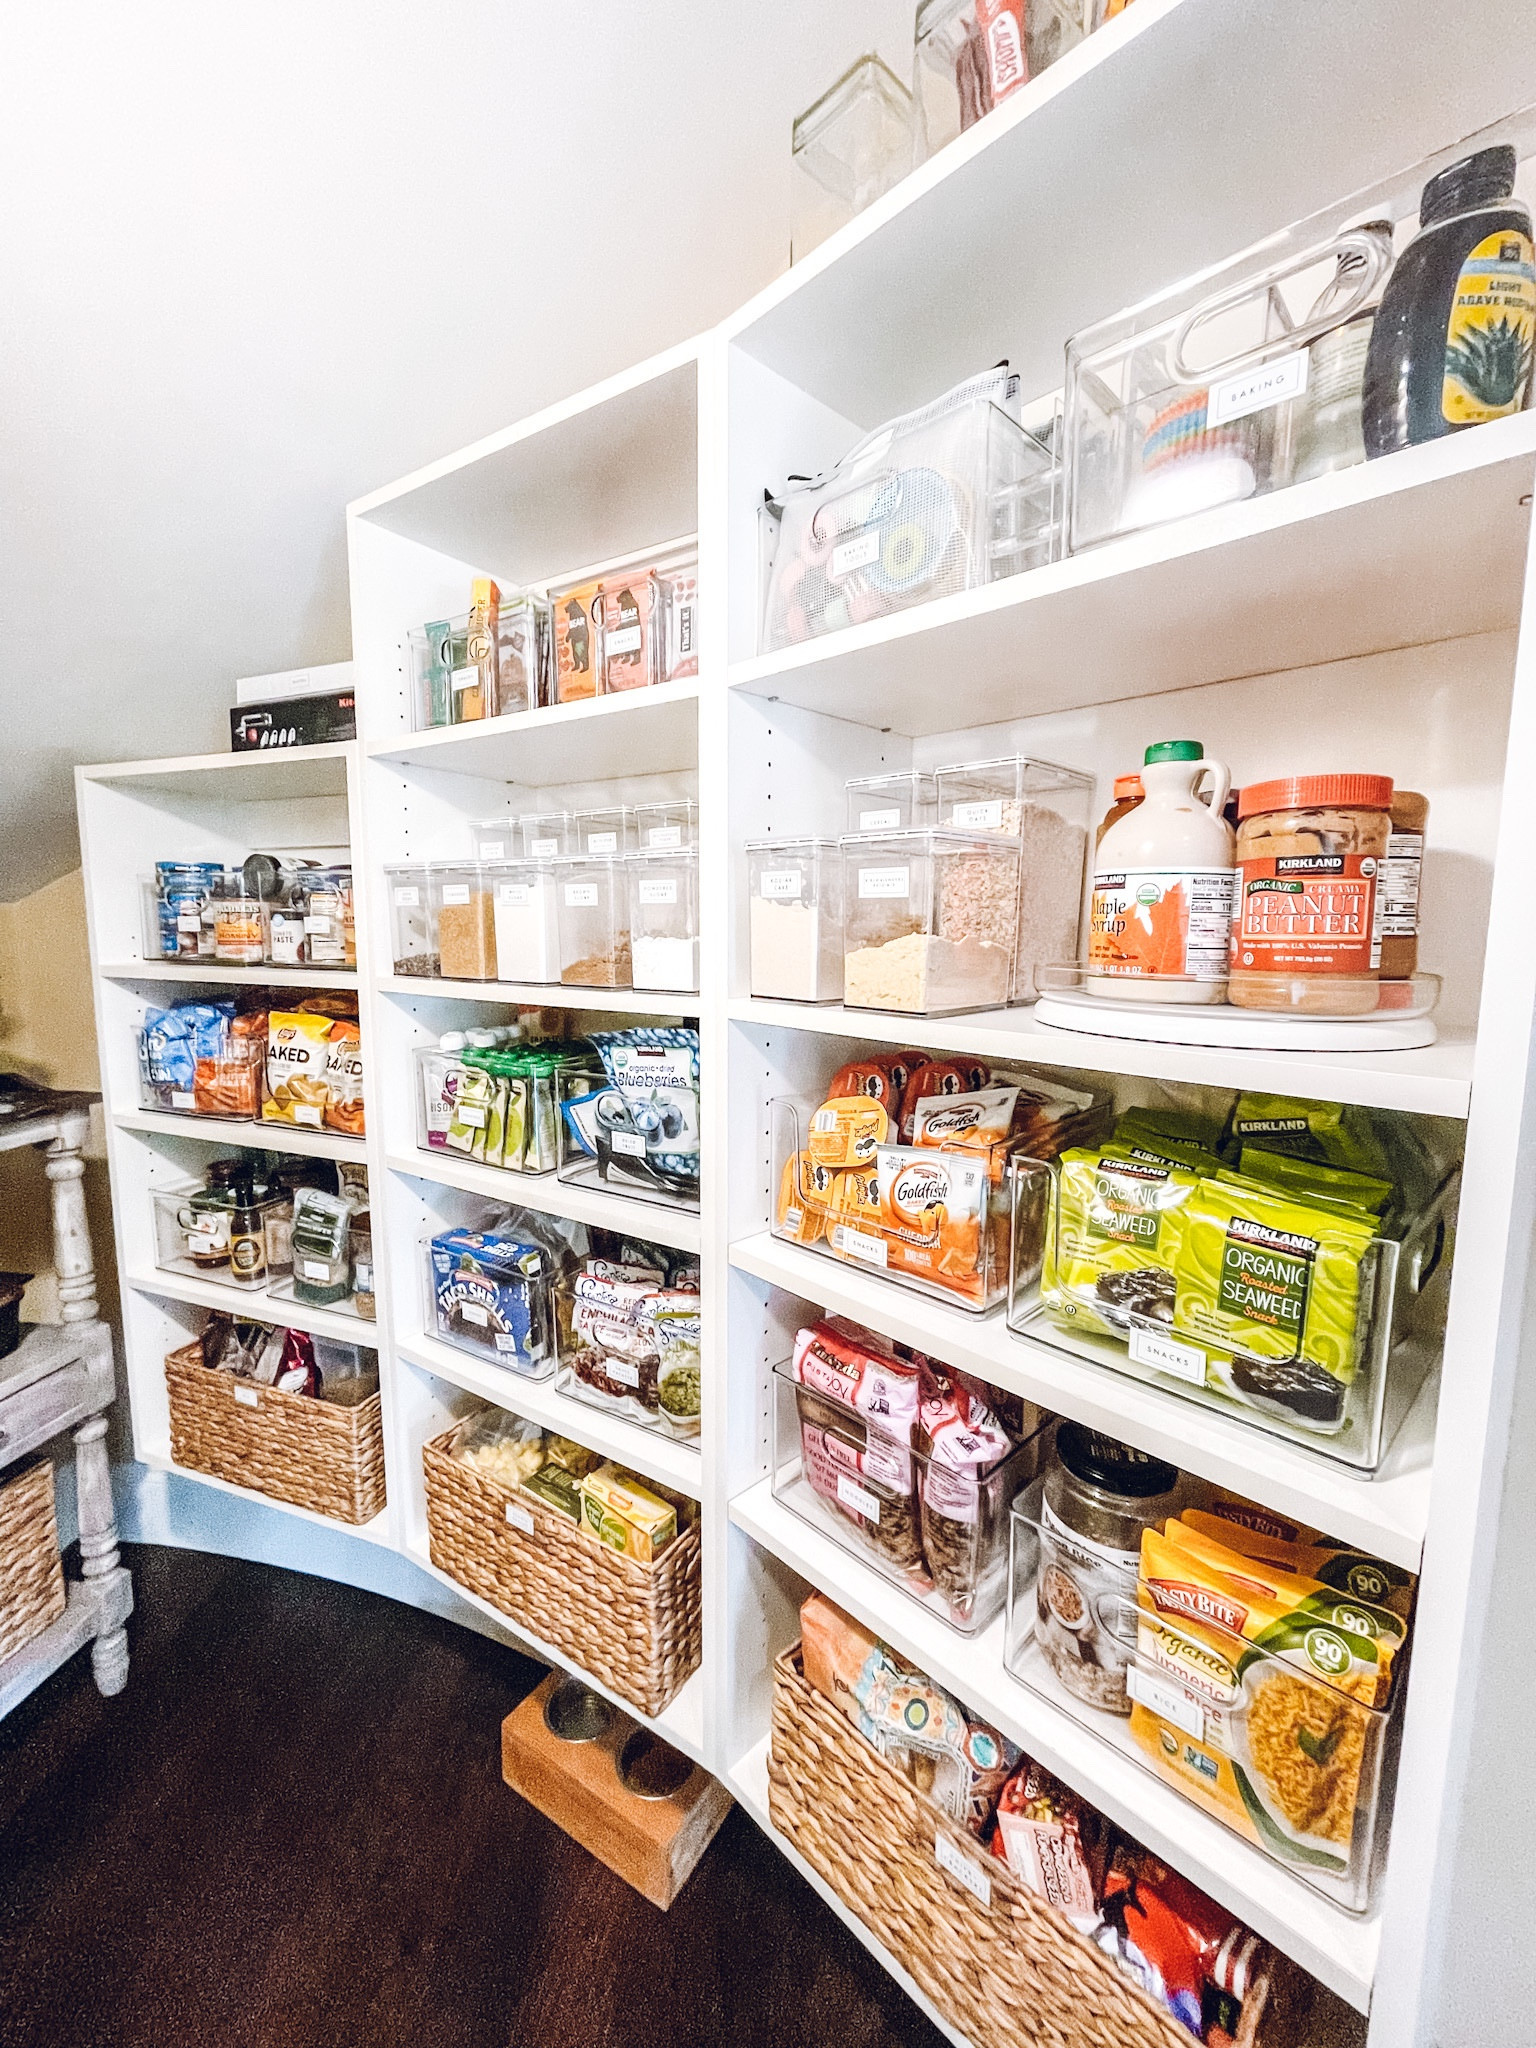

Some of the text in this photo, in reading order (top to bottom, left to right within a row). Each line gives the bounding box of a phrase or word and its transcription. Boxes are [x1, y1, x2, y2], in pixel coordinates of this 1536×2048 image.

[1457, 295, 1500, 306] AGAVE
[1230, 374, 1286, 402] BAKING
[1280, 858, 1342, 870] KIRKLAND
[1192, 878, 1220, 886] Nutrition
[1249, 880, 1297, 893] ORGANIC
[1308, 884, 1361, 893] CREAMY
[1190, 903, 1213, 911] Calories
[1248, 893, 1365, 915] PEANUT
[1247, 914, 1361, 935] BUTTER
[273, 936, 295, 944] PASTE
[268, 1045, 310, 1064] AKED
[618, 1071, 687, 1088] Blueberries
[628, 1064, 656, 1074] organic
[927, 1111, 981, 1134] Goldfish
[1240, 1119, 1307, 1133] KIRKLAND
[803, 1160, 814, 1191] Pringles
[1101, 1159, 1168, 1177] KIRKLAND
[852, 1172, 865, 1206] Pringles
[897, 1181, 948, 1201] Goldfish
[1097, 1179, 1161, 1207] ORGANIC
[1107, 1199, 1146, 1215] Roasted
[1091, 1210, 1157, 1237] SEAWEED
[1107, 1229, 1137, 1244] Snack
[1232, 1218, 1318, 1251] KIRKLAND
[852, 1239, 879, 1254] SNACKS
[1225, 1247, 1309, 1288] ORGANIC
[1239, 1272, 1289, 1295] Roasted
[438, 1282, 467, 1312] TACO
[1222, 1280, 1303, 1321] SEAWEED
[1242, 1304, 1279, 1326] Snack
[1146, 1344, 1190, 1367] SNACKS
[1356, 1574, 1382, 1594] 90
[1197, 1591, 1237, 1627] BITE
[1342, 1612, 1370, 1637] 90
[1152, 1620, 1231, 1677] Organic
[1314, 1637, 1343, 1663] 90
[1153, 1692, 1177, 1713] RICE
